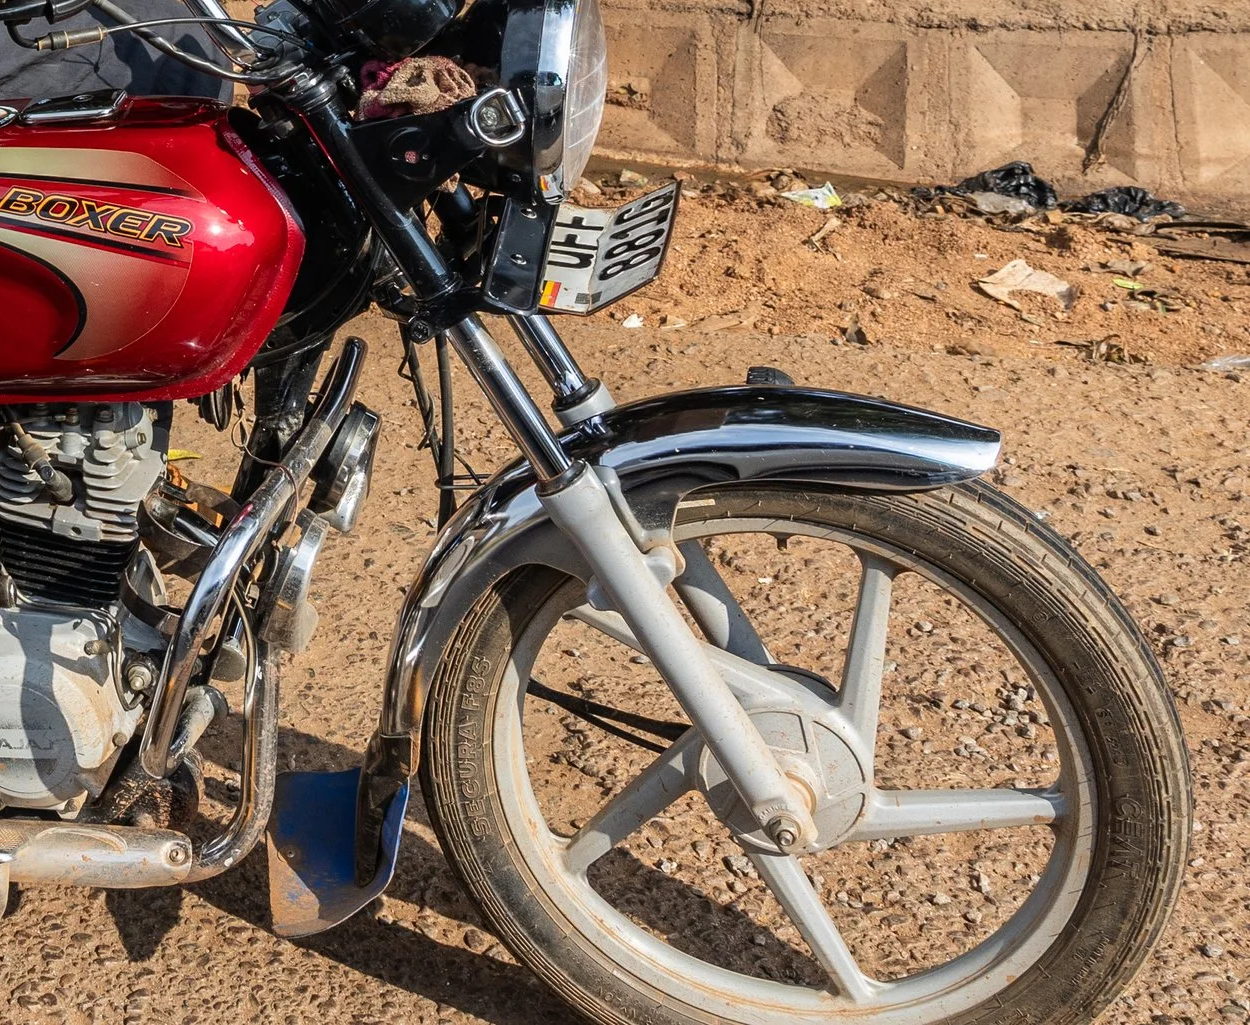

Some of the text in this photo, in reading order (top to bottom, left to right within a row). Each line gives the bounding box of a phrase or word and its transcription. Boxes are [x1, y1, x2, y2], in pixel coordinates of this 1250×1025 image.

[598, 189, 675, 281] 881G
[457, 655, 492, 838] SECURA F85
[1109, 795, 1144, 879] CEAT
